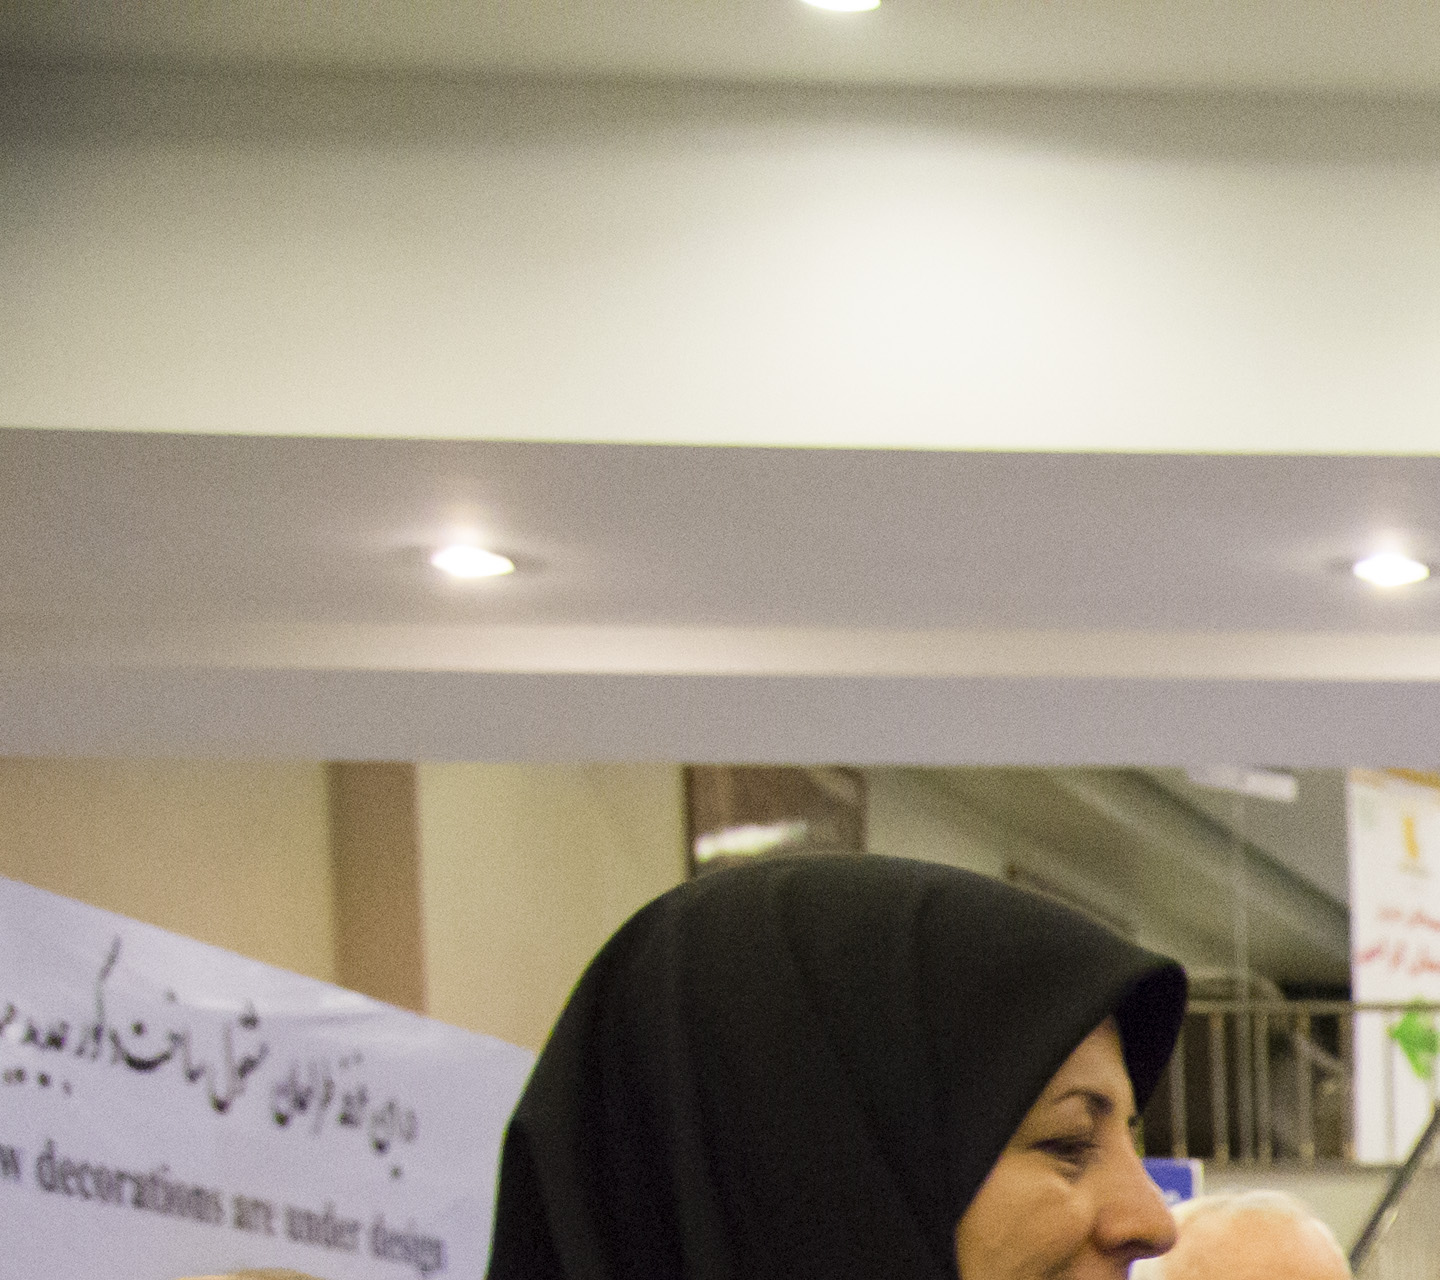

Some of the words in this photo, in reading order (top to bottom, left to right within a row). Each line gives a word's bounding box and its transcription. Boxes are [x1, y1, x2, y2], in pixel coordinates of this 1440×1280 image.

[36, 1138, 224, 1226] decorations
[232, 1193, 276, 1236] are
[284, 1201, 362, 1254] under
[369, 1211, 447, 1280] design
